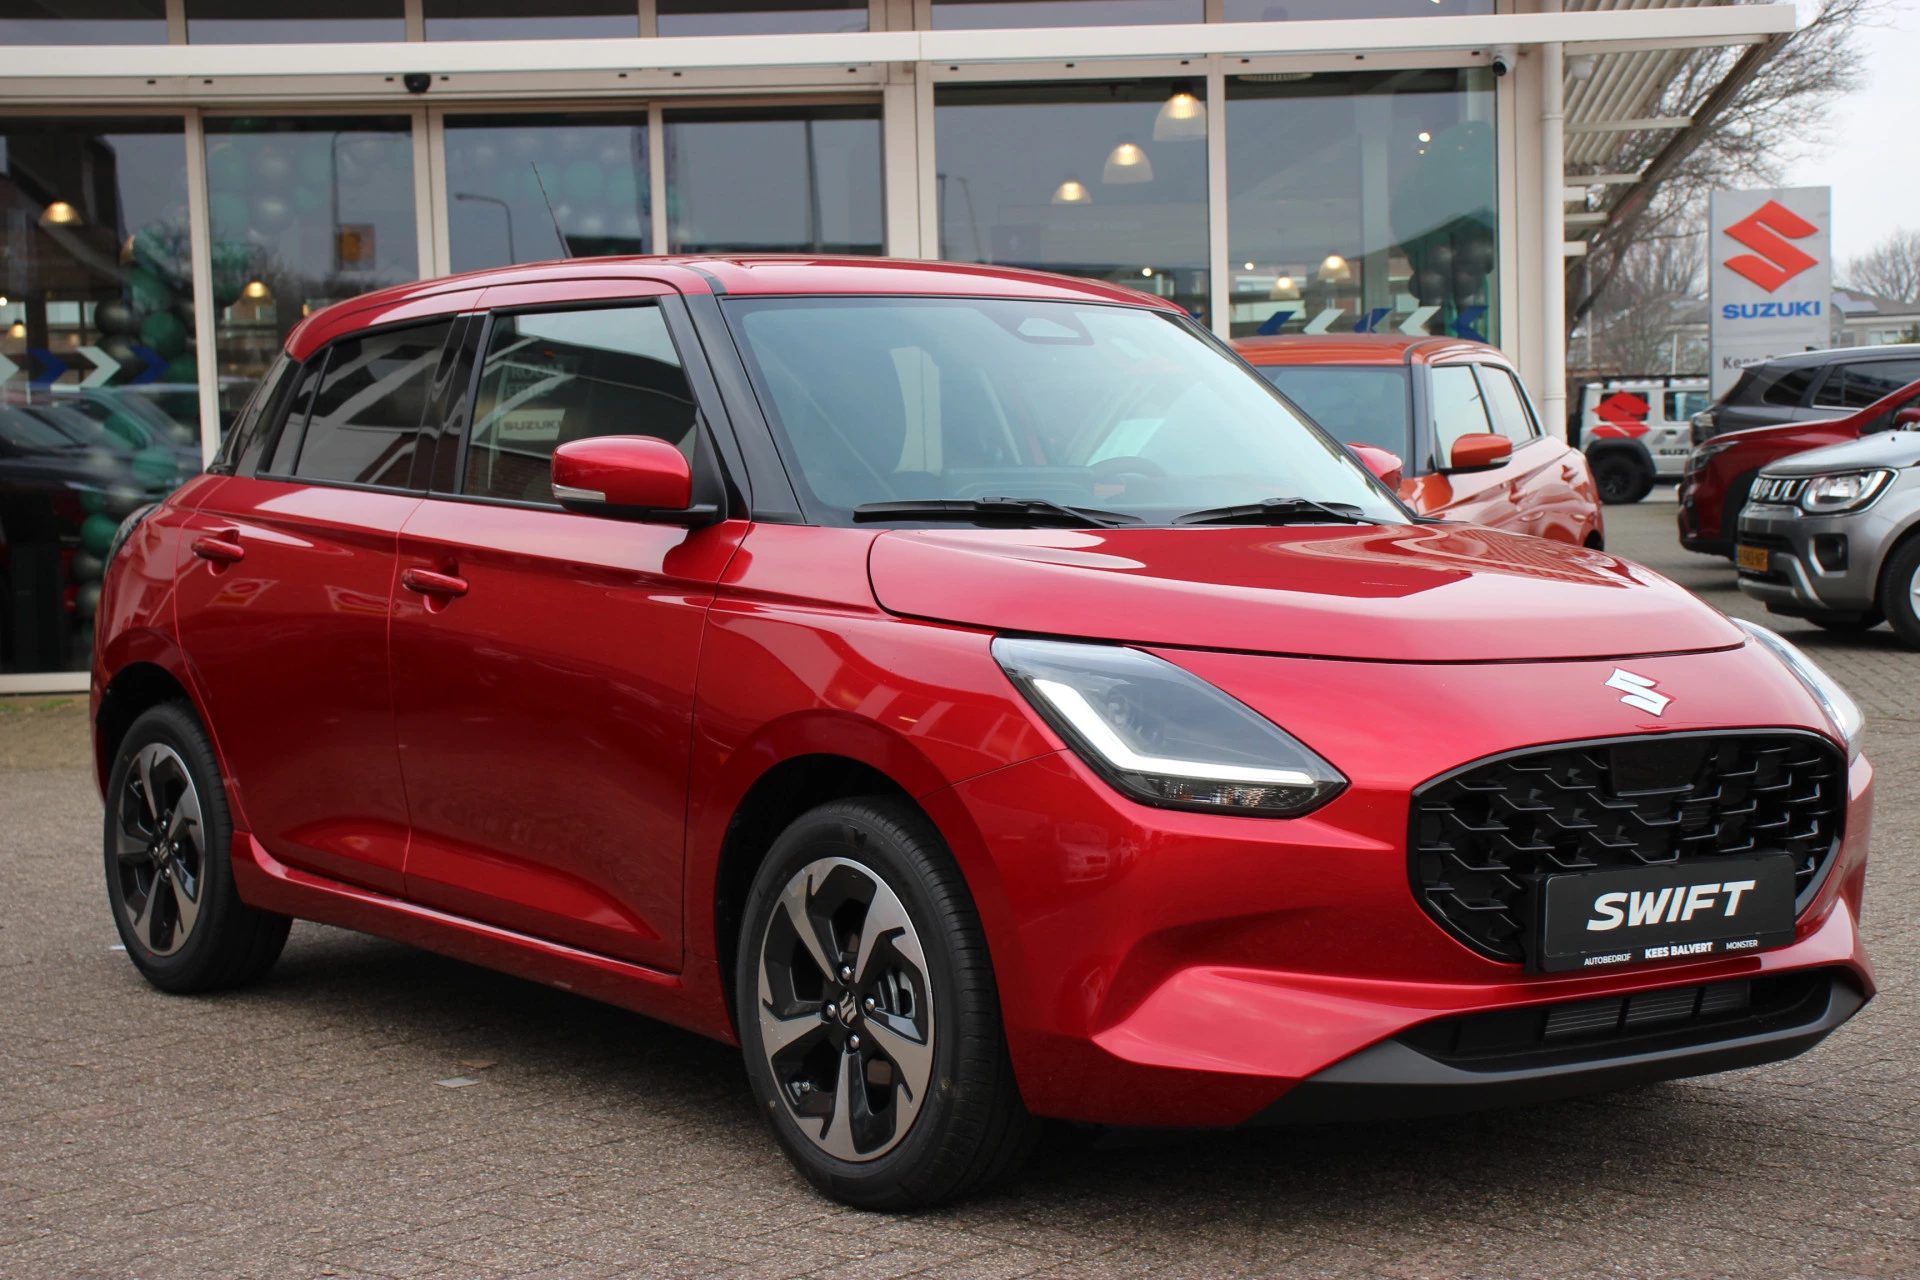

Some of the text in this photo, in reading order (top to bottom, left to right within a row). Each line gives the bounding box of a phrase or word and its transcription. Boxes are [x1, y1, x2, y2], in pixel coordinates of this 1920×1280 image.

[1722, 301, 1821, 319] SUZUKI
[1586, 879, 1756, 932] SWIFT
[1645, 947, 1669, 959] KEES
[1670, 942, 1713, 956] BALVERT
[1726, 939, 1758, 951] MONSTER
